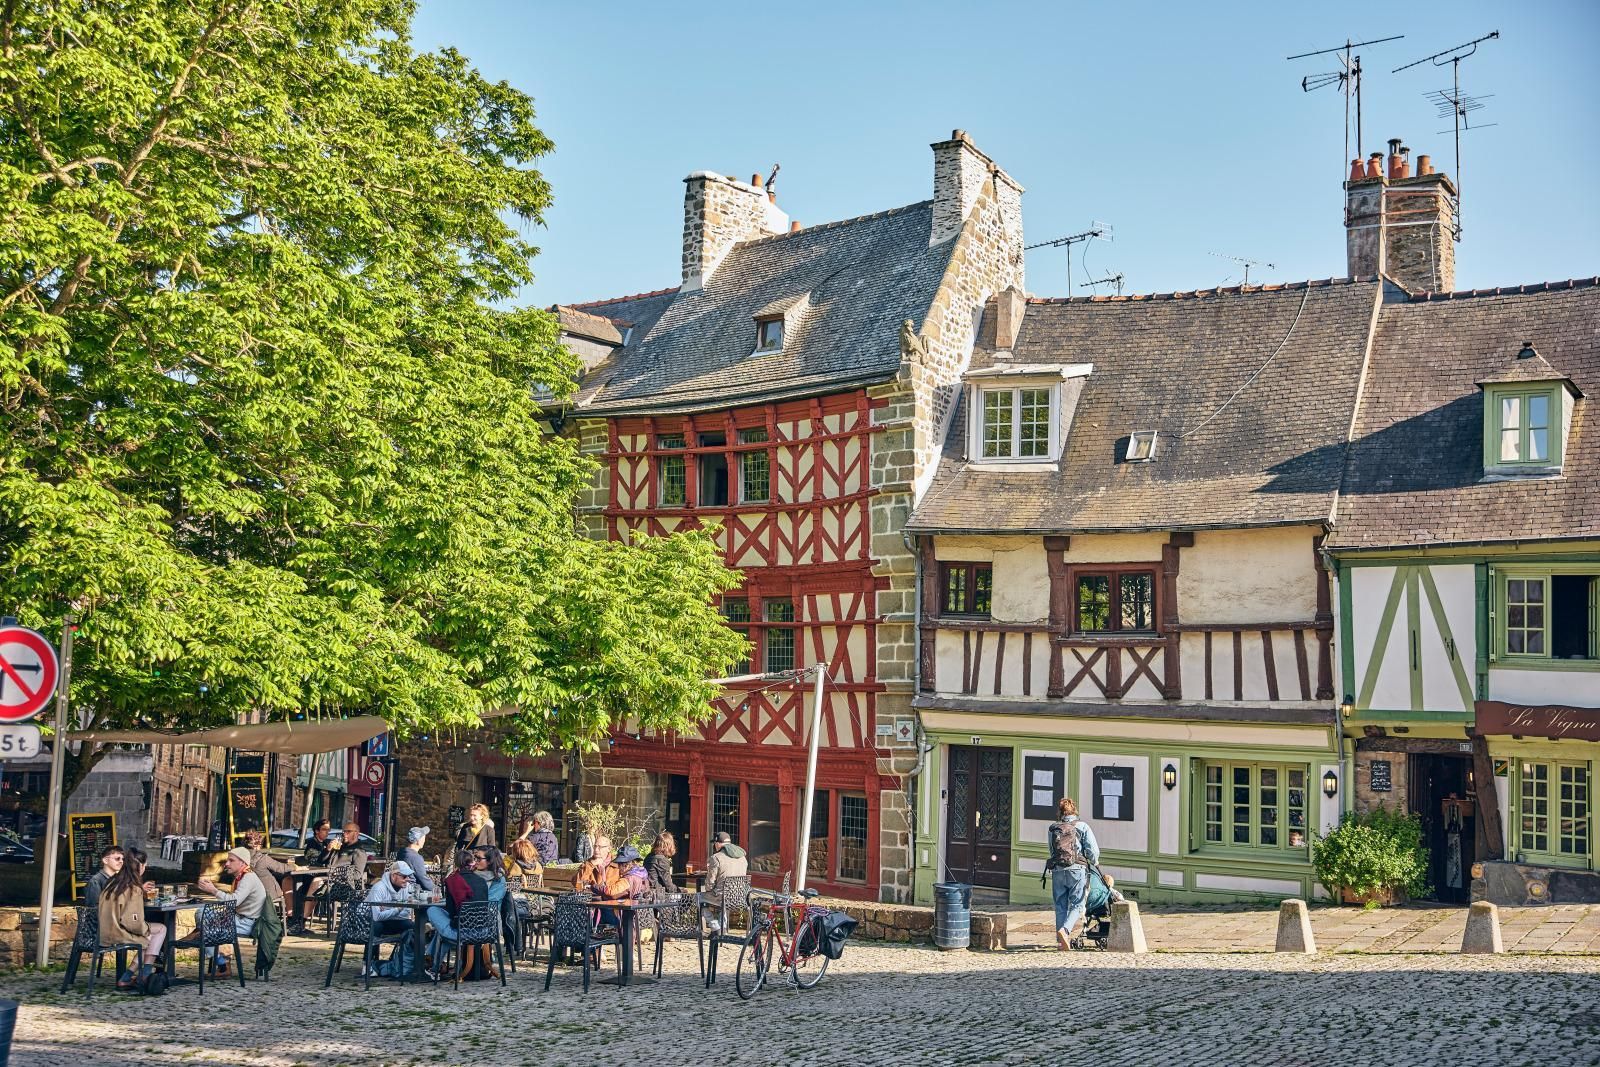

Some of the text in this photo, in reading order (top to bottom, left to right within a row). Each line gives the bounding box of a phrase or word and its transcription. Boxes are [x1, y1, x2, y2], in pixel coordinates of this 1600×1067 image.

[1508, 707, 1596, 736] La Vigna
[972, 737, 980, 745] 17
